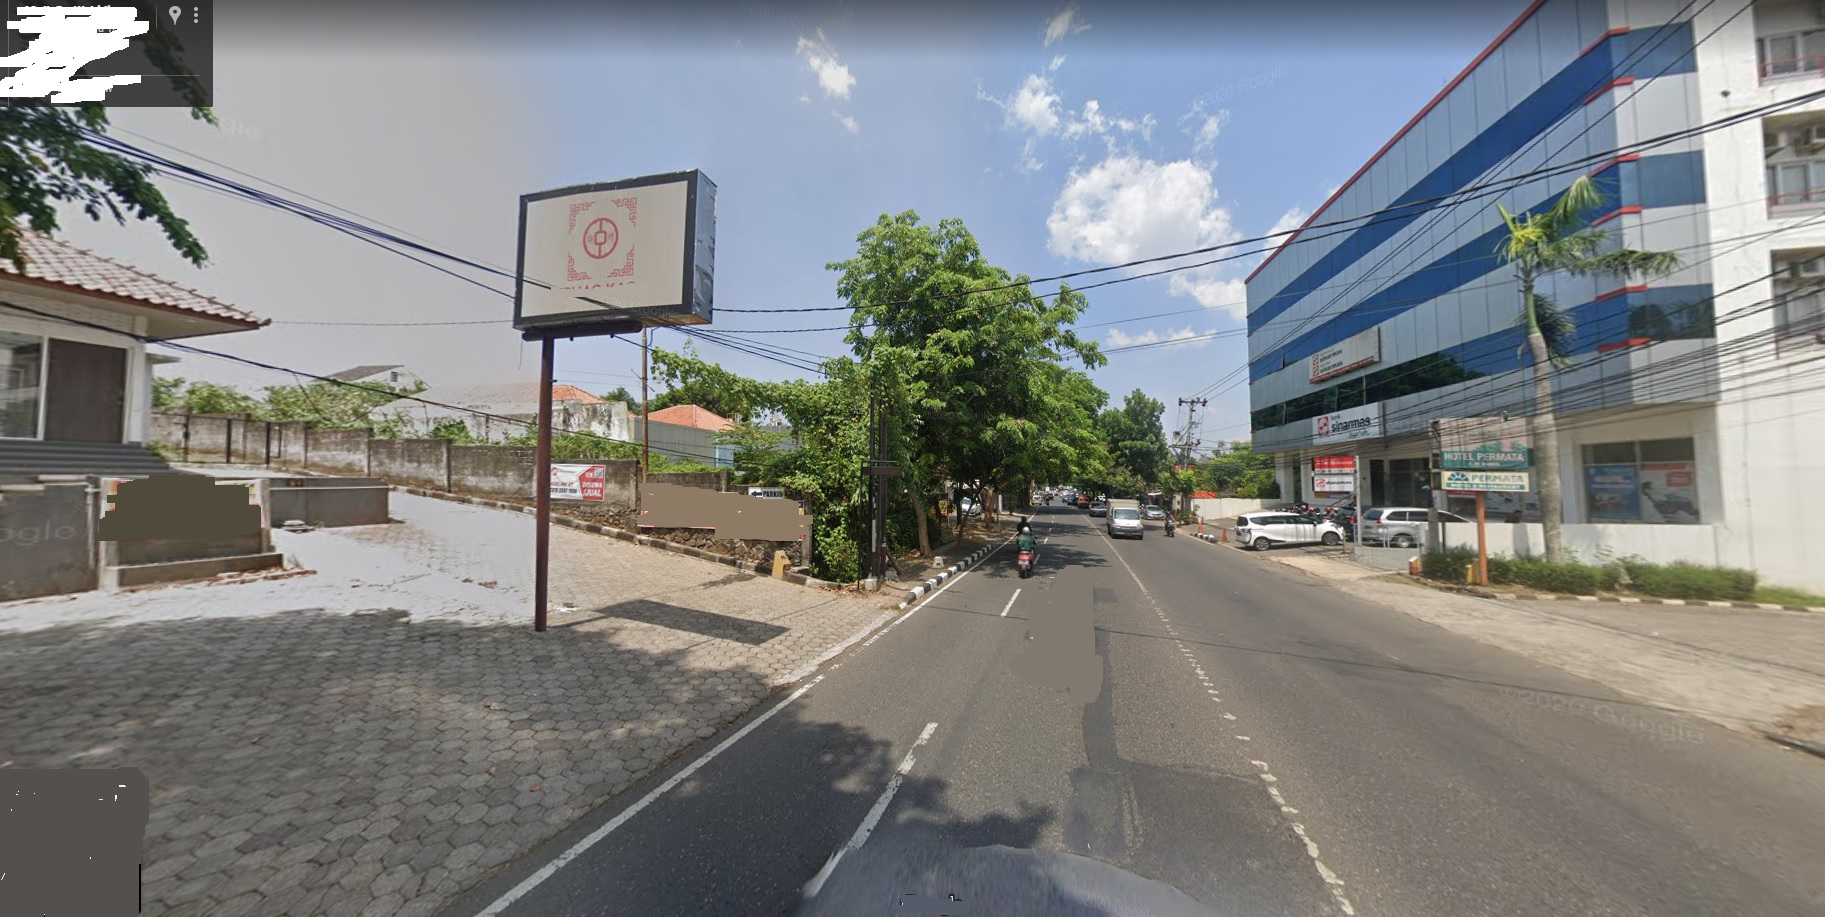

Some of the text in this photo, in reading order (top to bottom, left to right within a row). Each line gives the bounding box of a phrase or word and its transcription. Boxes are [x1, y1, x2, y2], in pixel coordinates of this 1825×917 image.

[1331, 416, 1371, 432] sinarmas
[1444, 453, 1525, 462] HOTEL PERMATA
